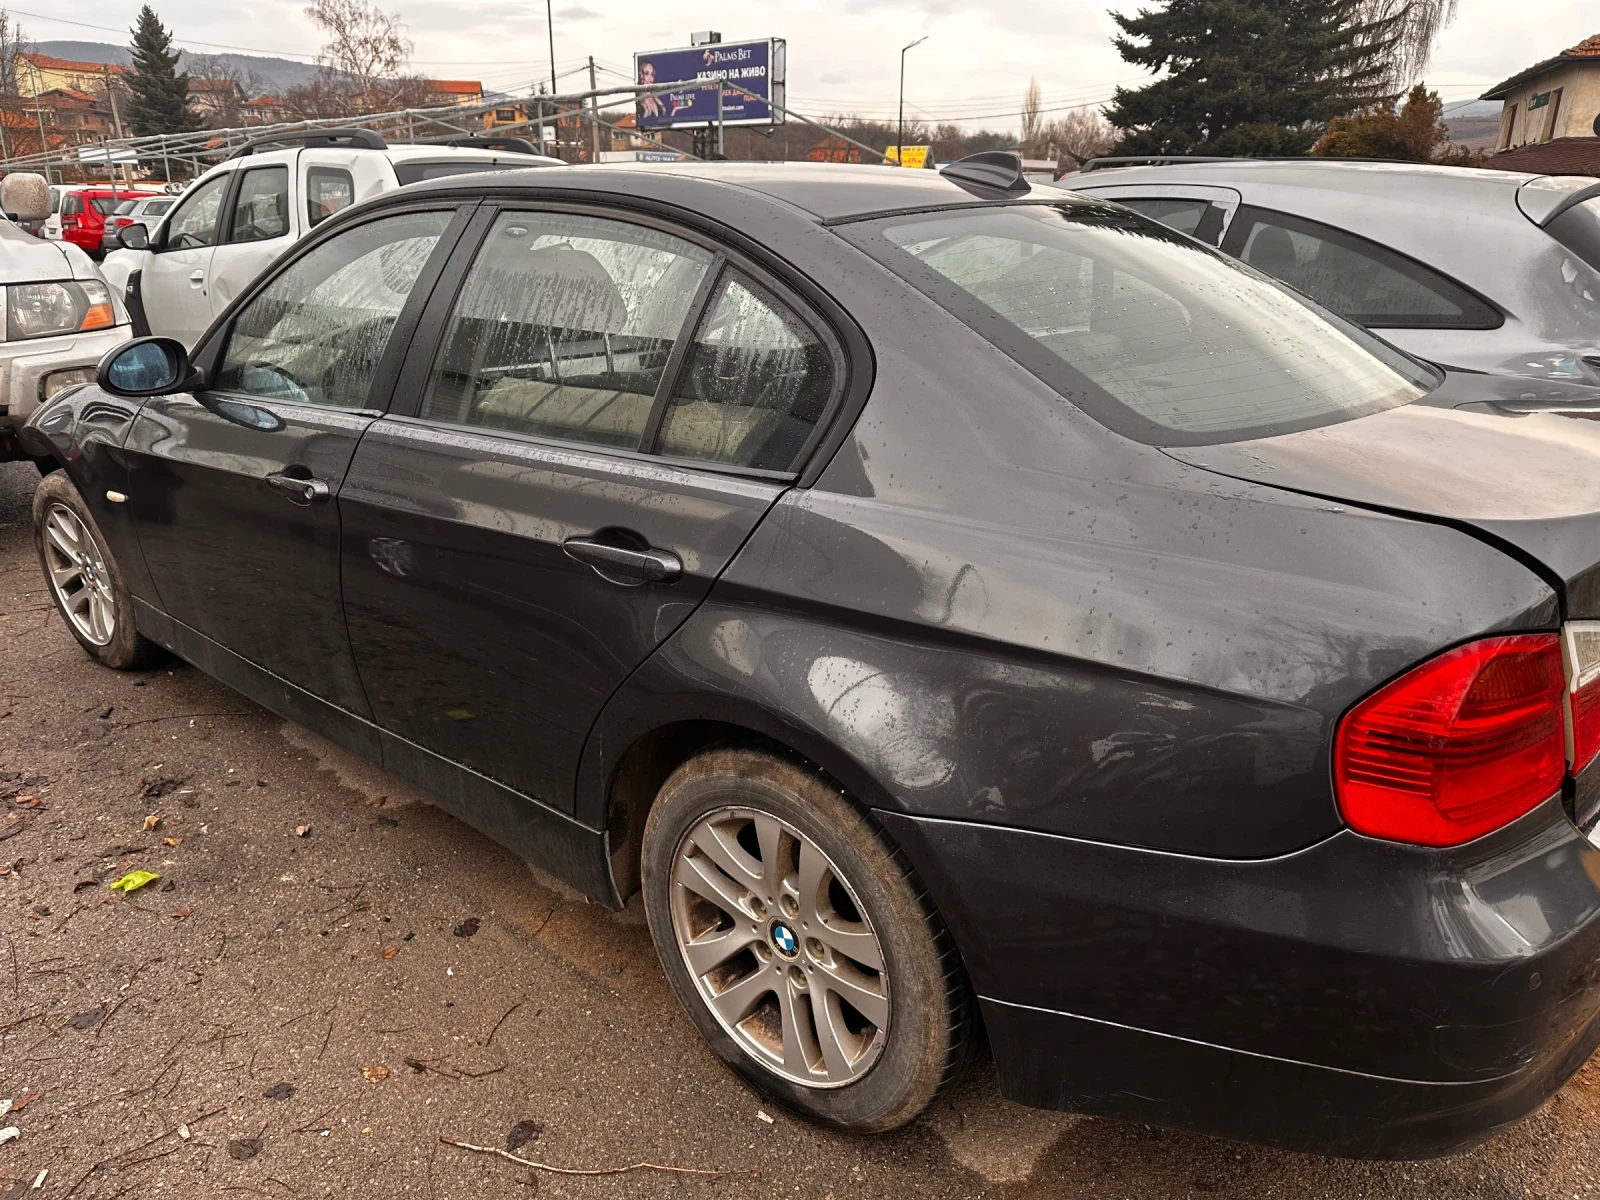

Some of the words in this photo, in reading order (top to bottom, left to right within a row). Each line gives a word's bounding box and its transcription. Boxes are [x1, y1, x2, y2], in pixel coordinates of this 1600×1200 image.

[714, 51, 738, 62] PALMS
[738, 48, 752, 60] BET
[697, 69, 727, 79] КАЗИНО
[729, 69, 740, 78] НА
[741, 66, 766, 77] ЖИВО
